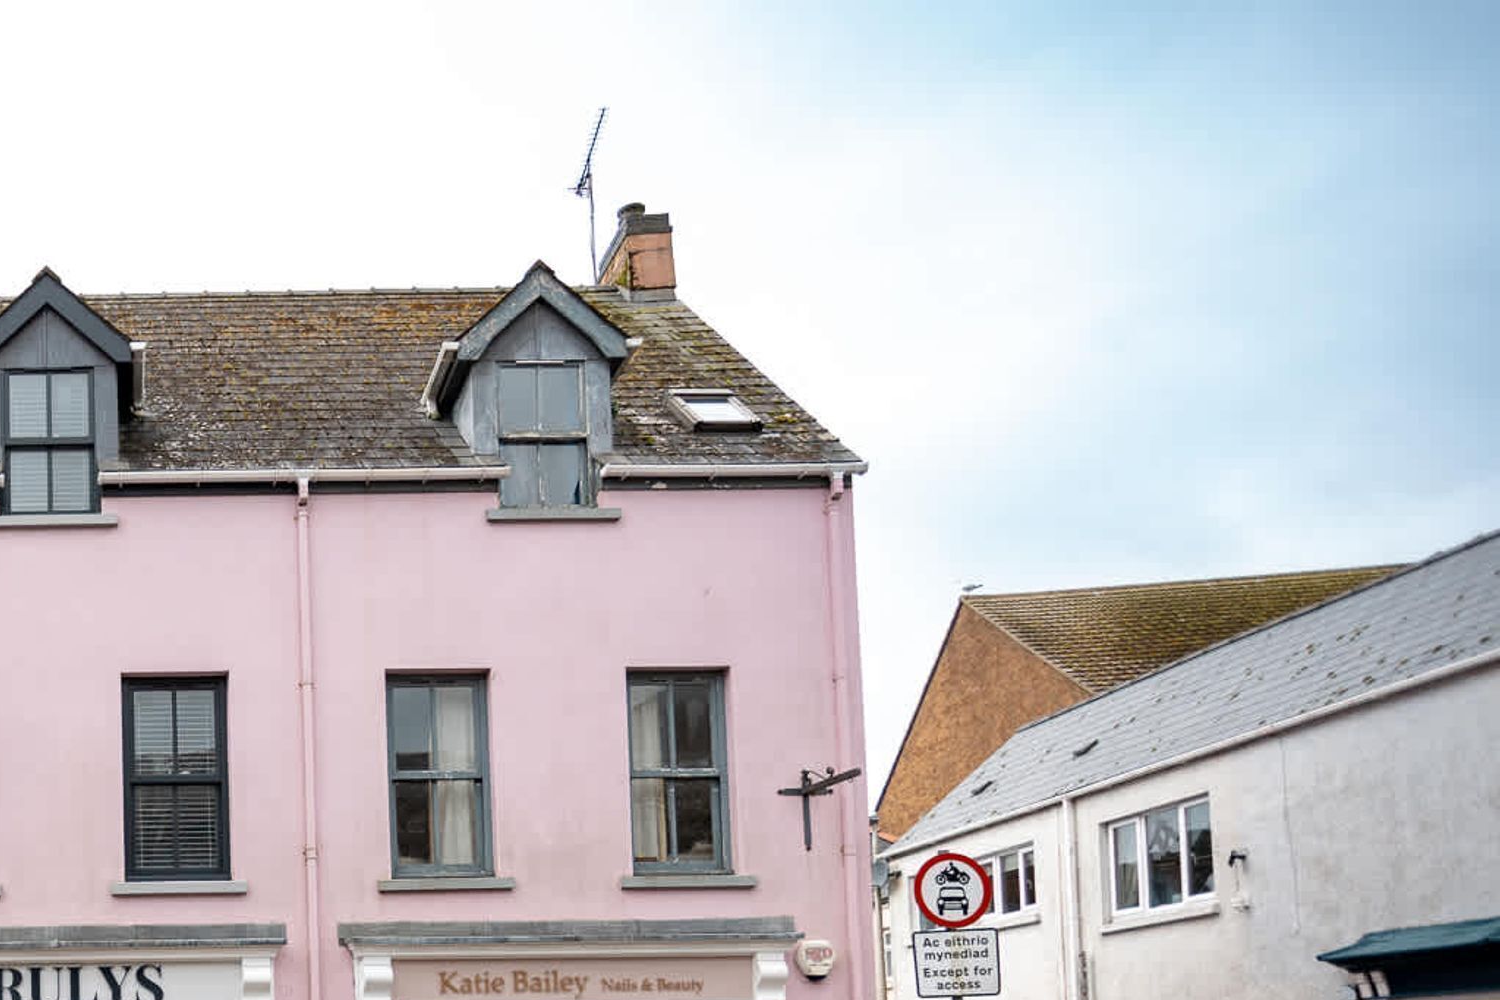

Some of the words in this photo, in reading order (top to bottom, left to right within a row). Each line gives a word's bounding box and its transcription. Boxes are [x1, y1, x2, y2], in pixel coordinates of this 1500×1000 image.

[923, 937, 940, 947] Ac
[944, 934, 989, 947] eithrio
[924, 948, 989, 962] mynediad
[923, 967, 969, 978] Except
[974, 965, 993, 976] for
[438, 970, 505, 995] Katie
[512, 970, 589, 1000] Bailey
[601, 978, 638, 992] Nails
[641, 978, 654, 992] &
[657, 978, 705, 995] Beauty
[937, 981, 981, 990] access
